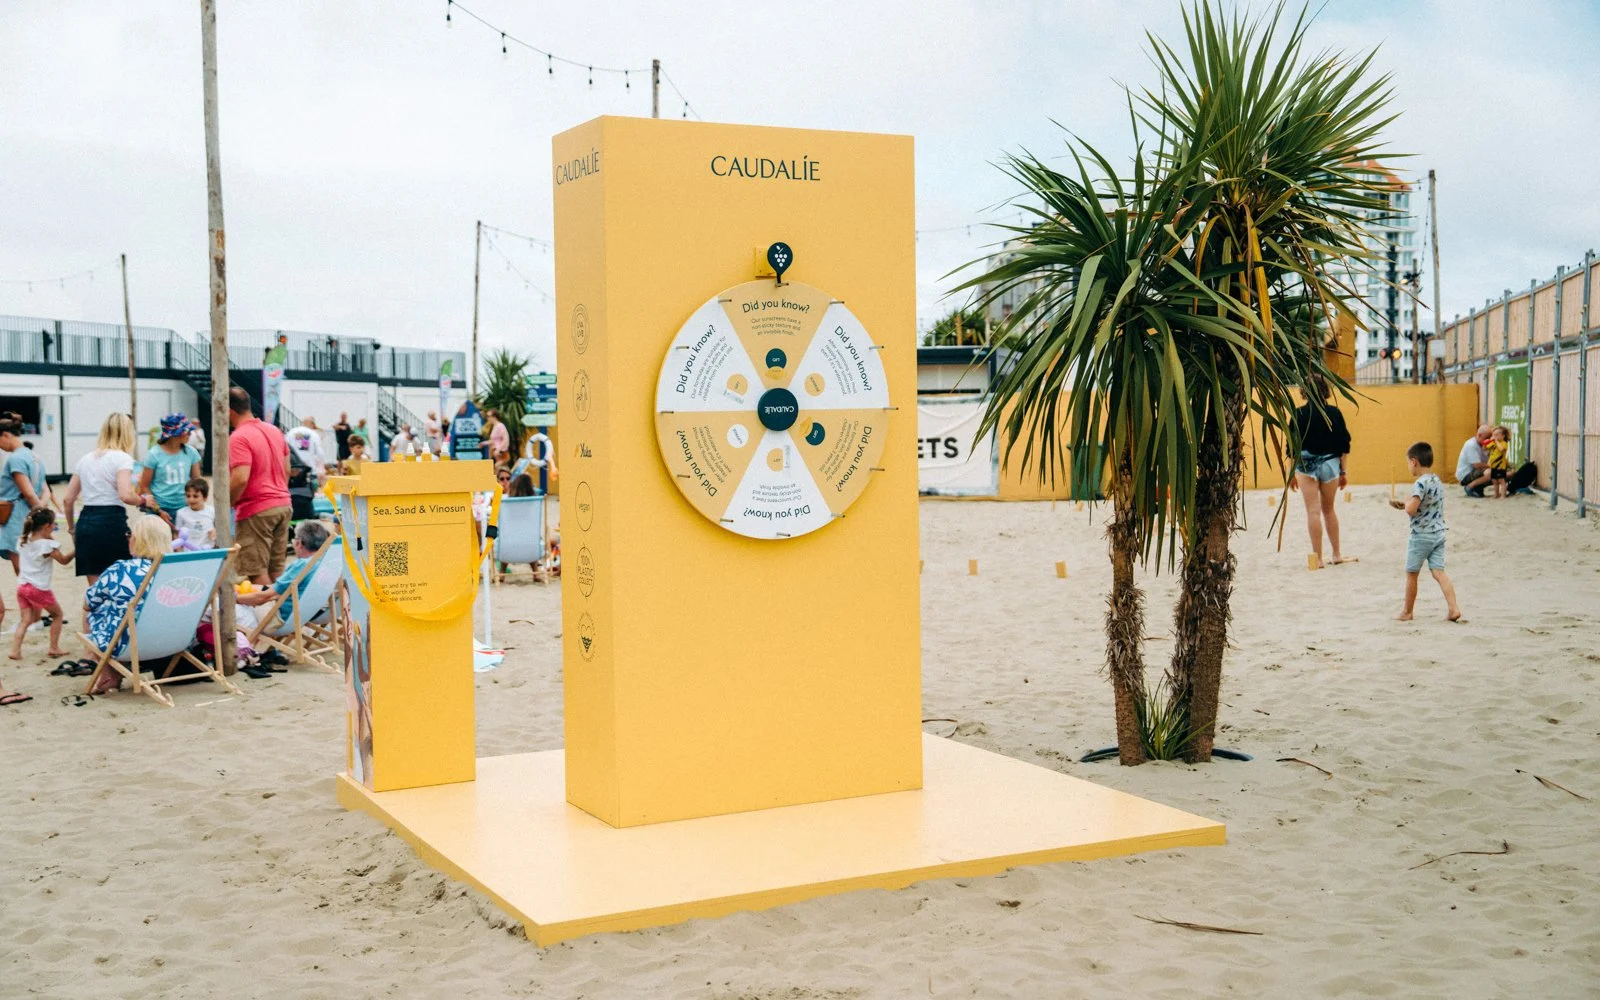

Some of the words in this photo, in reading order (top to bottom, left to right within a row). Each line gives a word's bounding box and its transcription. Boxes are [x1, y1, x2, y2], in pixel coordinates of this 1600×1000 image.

[556, 147, 599, 185] CAUDALÍE
[711, 155, 820, 181] CAUDALÍE
[743, 300, 759, 313] Did
[762, 301, 778, 310] you
[782, 299, 810, 313] know?
[676, 374, 687, 393] Did
[684, 354, 696, 374] you
[692, 325, 715, 353] know?
[835, 326, 850, 343] Did
[845, 343, 859, 360] you
[857, 361, 872, 391] know?
[764, 406, 794, 414] CAUDALÍE
[862, 426, 872, 444] Did
[677, 430, 693, 462] know?
[854, 444, 865, 463] you
[165, 461, 185, 485] hi
[691, 462, 706, 480] you
[836, 464, 858, 492] know?
[701, 480, 717, 496] Did
[395, 506, 416, 514] Sand
[744, 508, 772, 520] know?
[776, 508, 791, 518] you
[795, 505, 810, 517] Did
